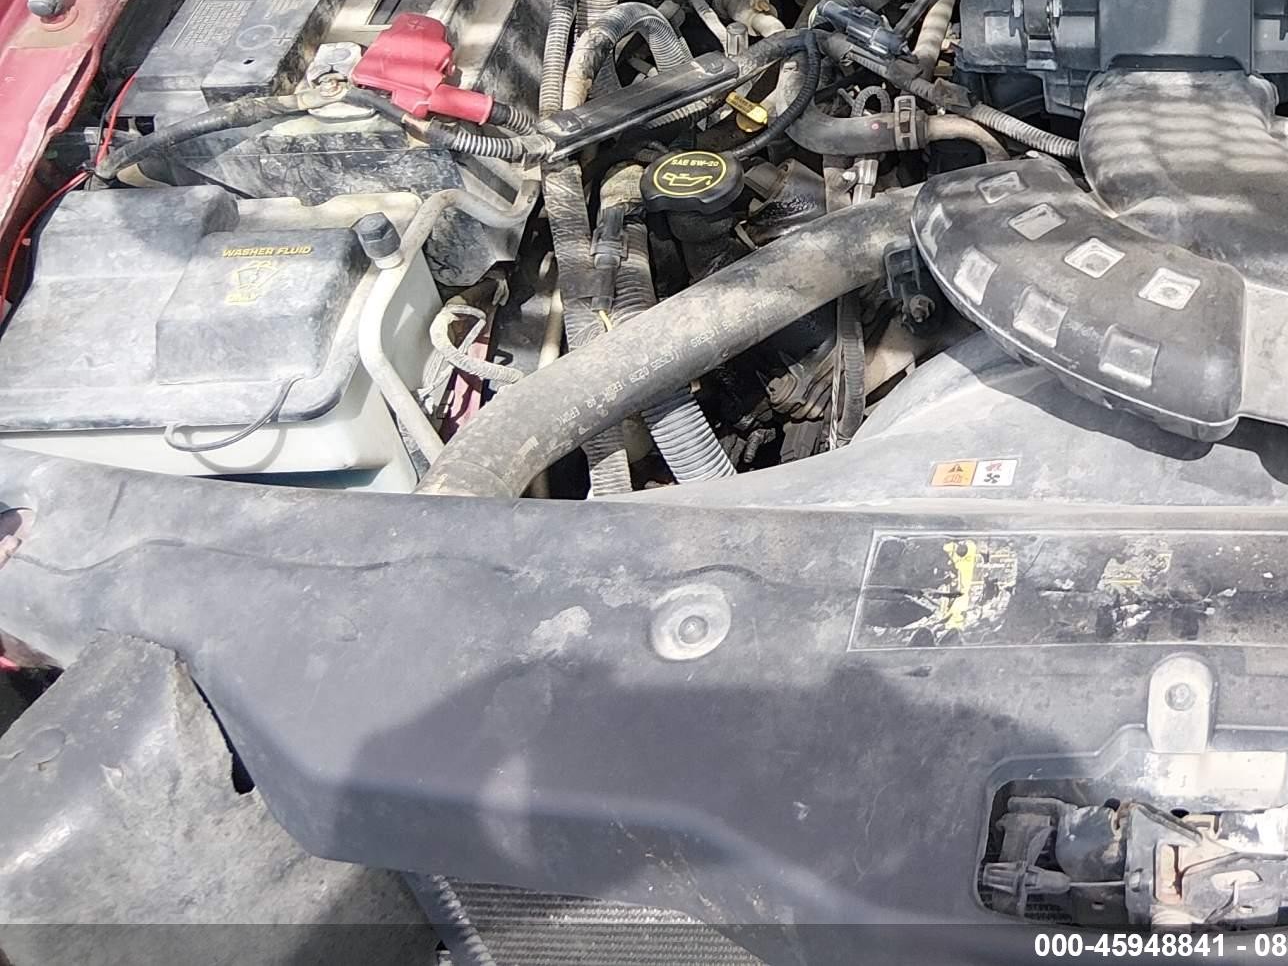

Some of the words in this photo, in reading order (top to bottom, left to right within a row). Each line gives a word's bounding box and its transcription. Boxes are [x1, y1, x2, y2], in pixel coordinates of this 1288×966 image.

[690, 159, 720, 167] 5W-20
[223, 247, 274, 258] WASHER
[275, 246, 314, 256] FLUID
